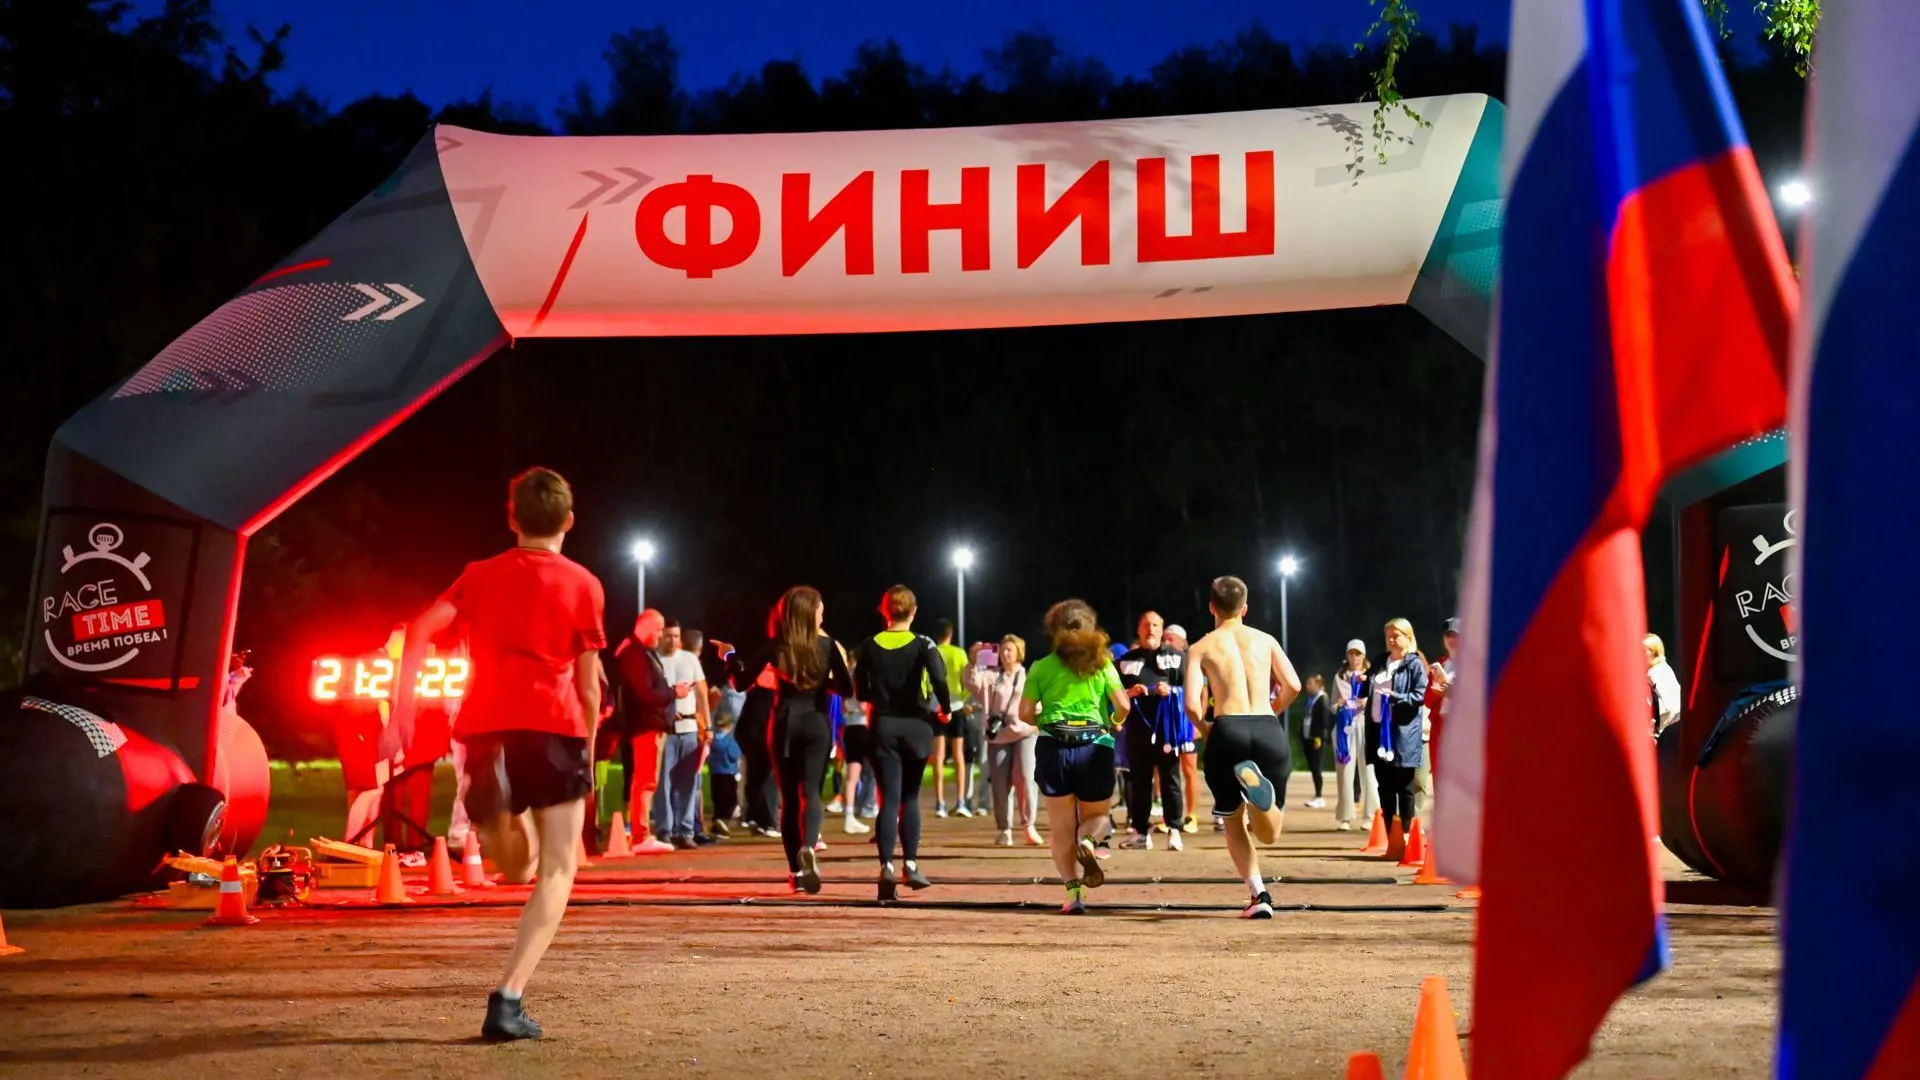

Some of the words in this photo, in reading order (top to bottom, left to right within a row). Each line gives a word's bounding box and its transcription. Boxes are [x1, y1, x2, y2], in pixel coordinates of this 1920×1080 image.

[635, 149, 1275, 279] ФИНИШ
[43, 578, 118, 623] RACE
[81, 604, 151, 635] TIME
[67, 638, 110, 657] ВРЕМЯ
